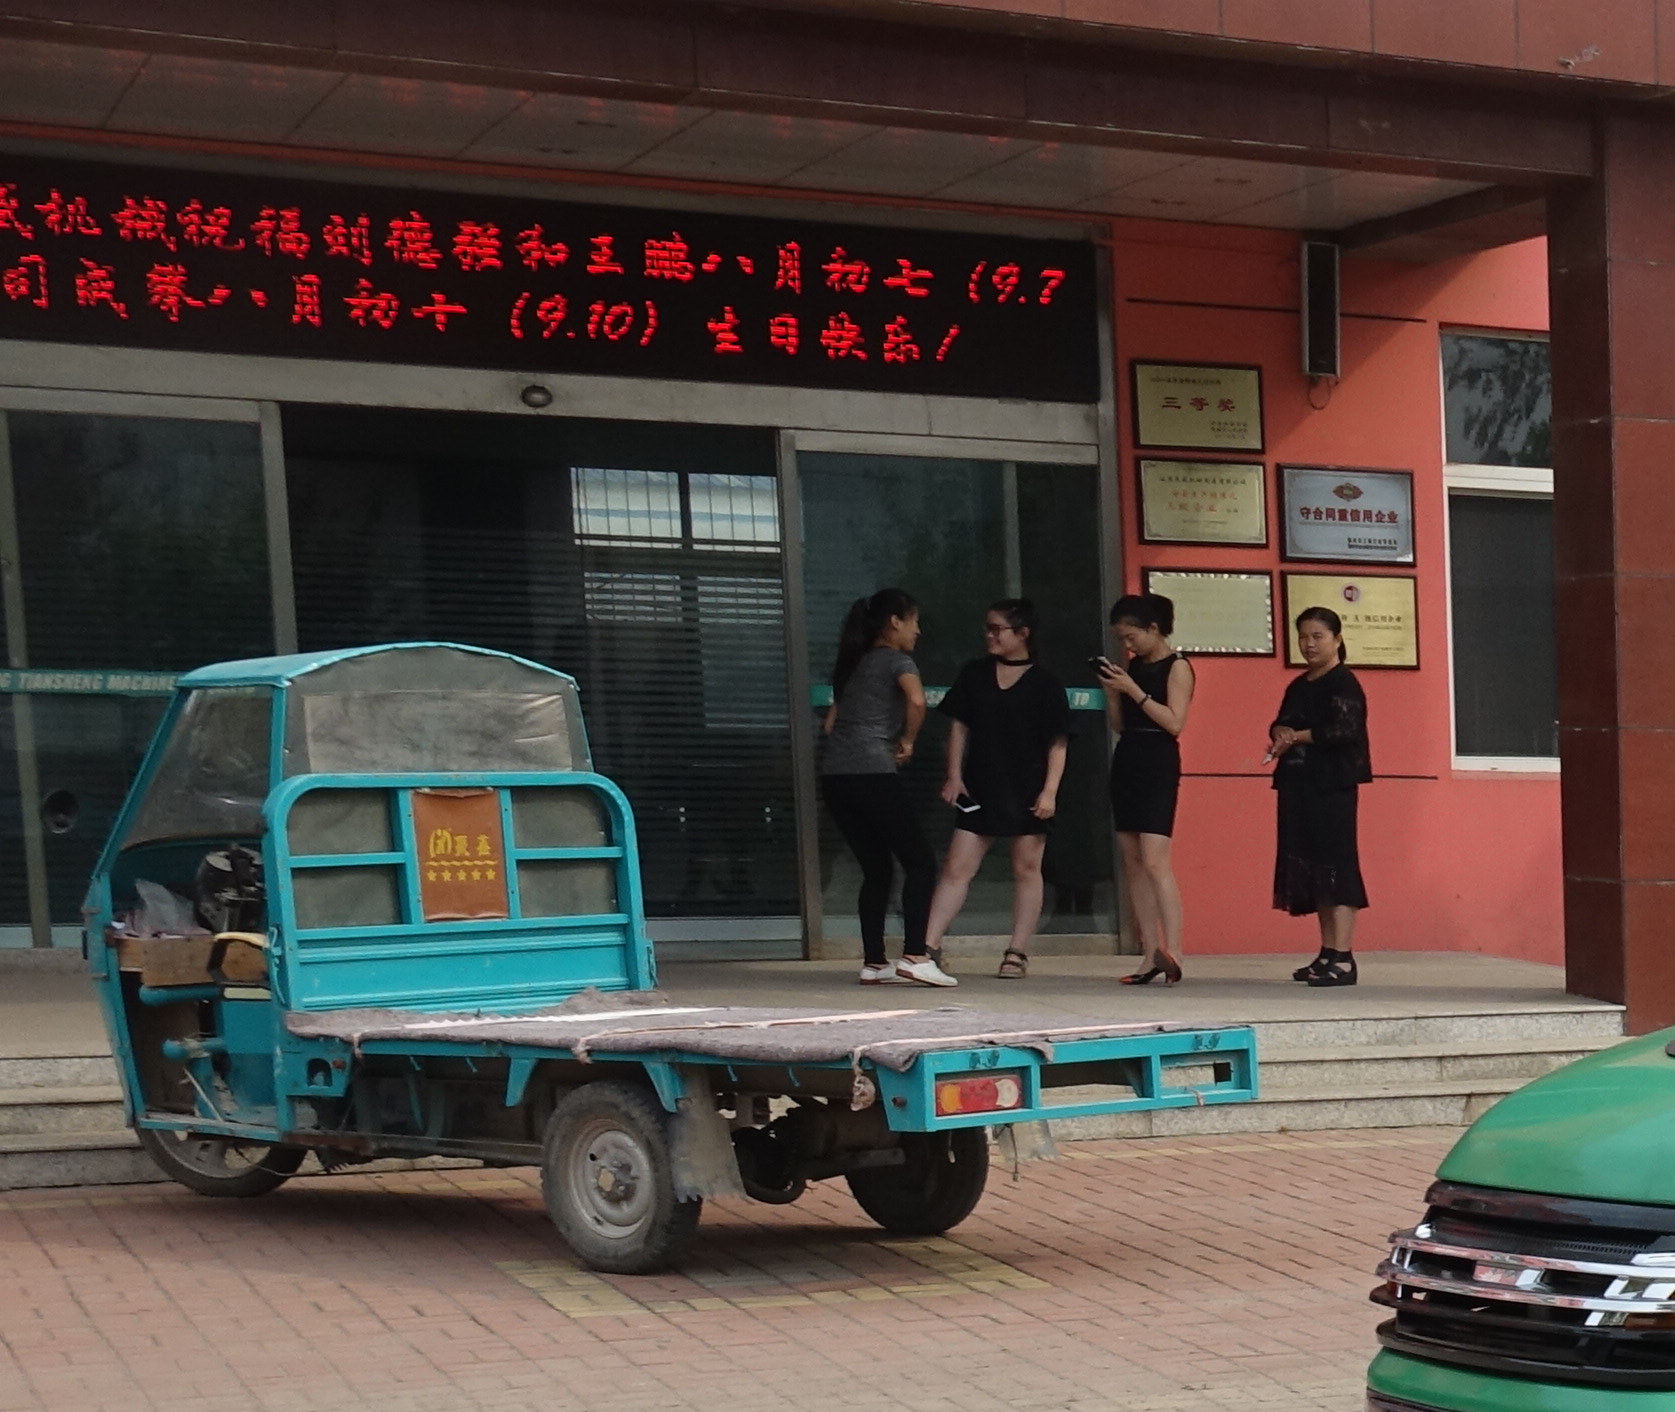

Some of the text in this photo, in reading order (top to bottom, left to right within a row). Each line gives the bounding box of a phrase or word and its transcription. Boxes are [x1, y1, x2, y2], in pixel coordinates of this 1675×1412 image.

[1162, 396, 1236, 412] 三等奖
[1300, 506, 1398, 524] 守合同重信用企业
